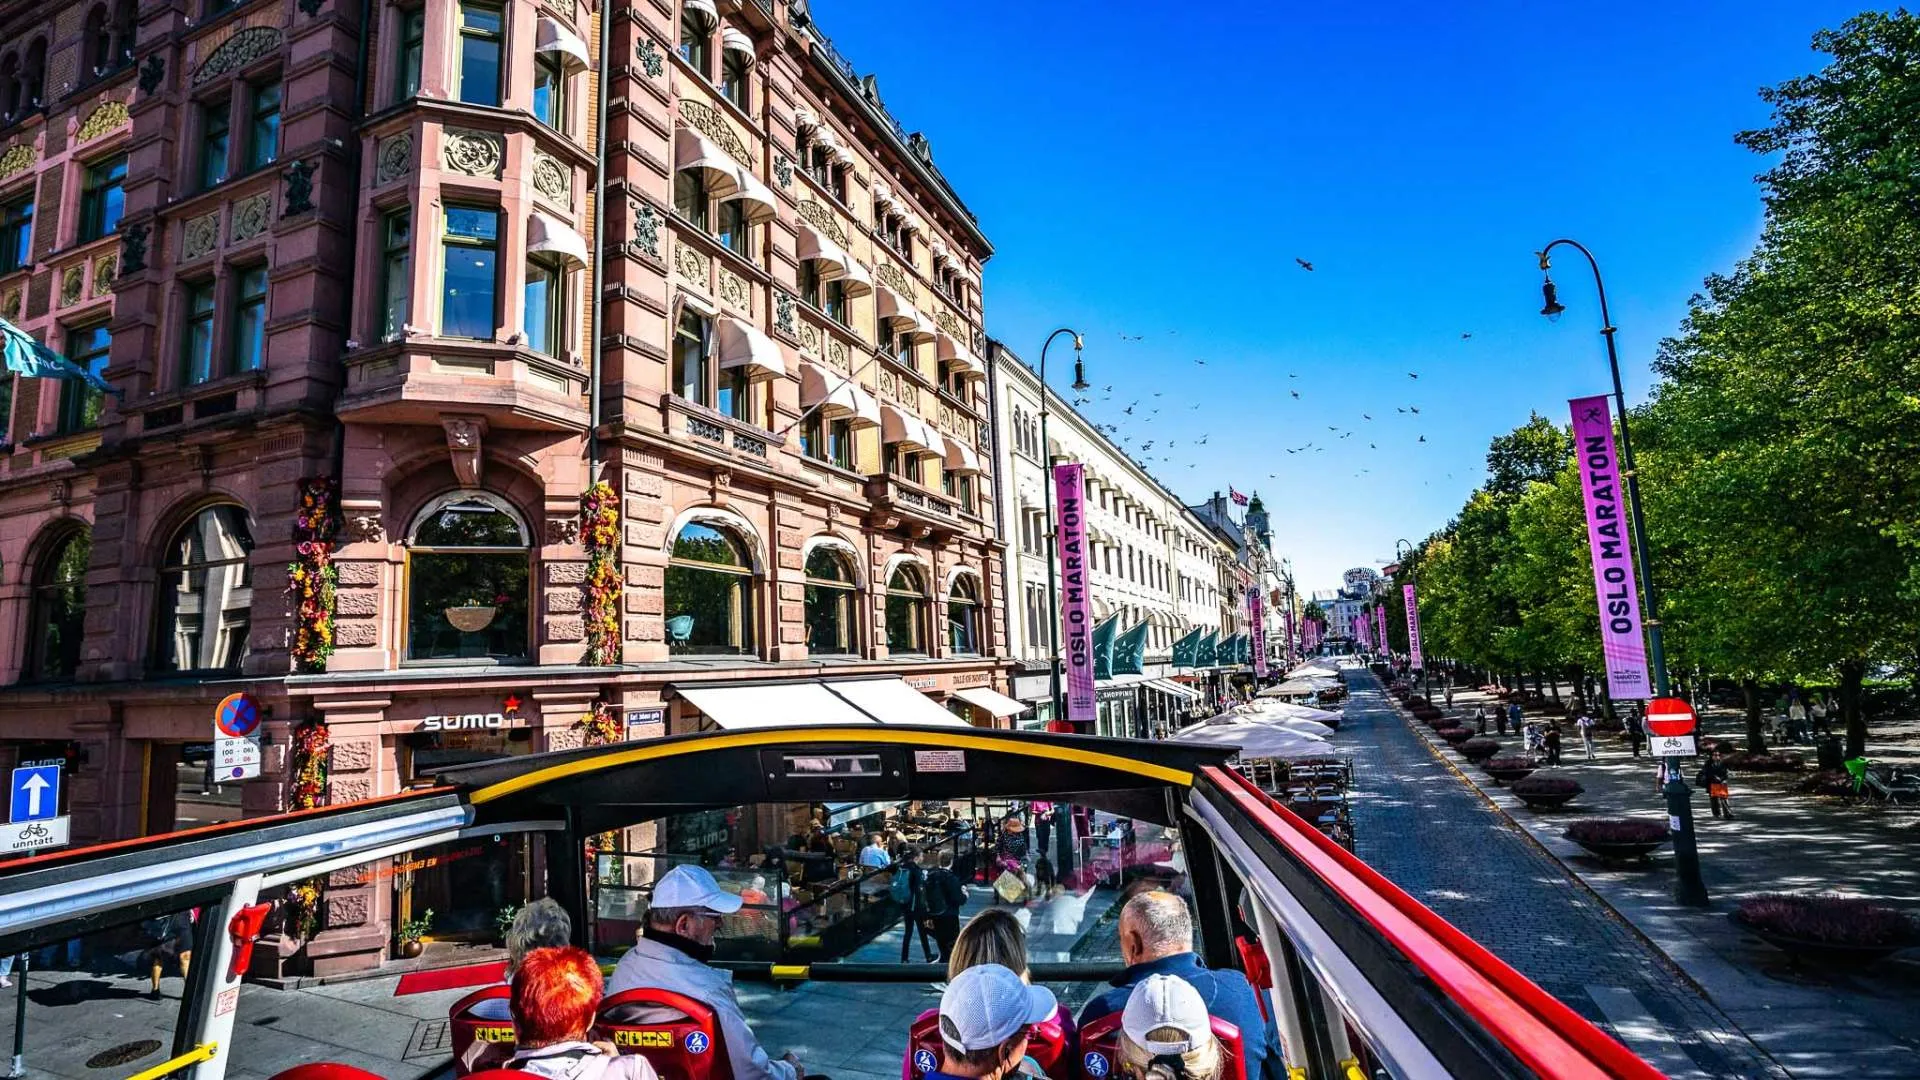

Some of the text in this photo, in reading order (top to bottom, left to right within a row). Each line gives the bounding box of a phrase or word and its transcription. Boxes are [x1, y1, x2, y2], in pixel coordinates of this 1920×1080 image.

[1584, 435, 1620, 559] MARATON
[1062, 498, 1085, 667] OSLO MARATON
[1603, 567, 1632, 634] OSLO
[424, 713, 504, 731] SUMO
[12, 836, 54, 849] unntatt
[687, 829, 728, 851] SUMO
